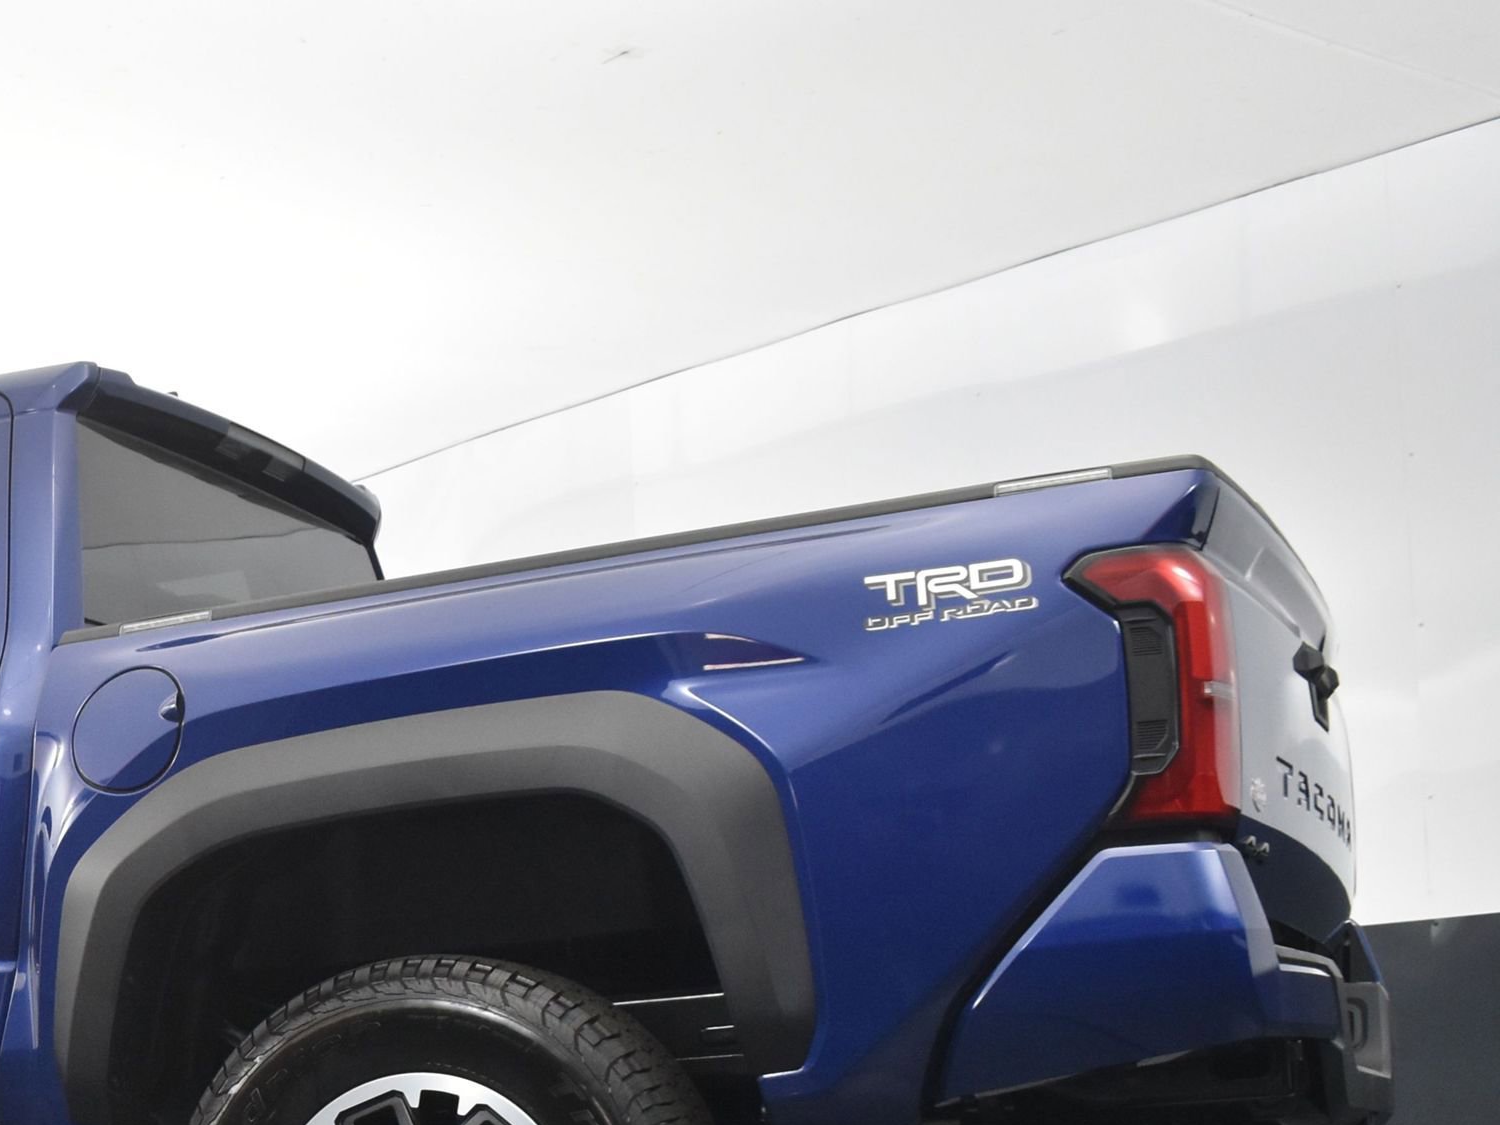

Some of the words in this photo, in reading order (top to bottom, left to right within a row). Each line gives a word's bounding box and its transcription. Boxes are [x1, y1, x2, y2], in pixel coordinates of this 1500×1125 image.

[863, 558, 1032, 610] TRD
[864, 610, 934, 631] OFF
[940, 596, 1040, 622] ROAD
